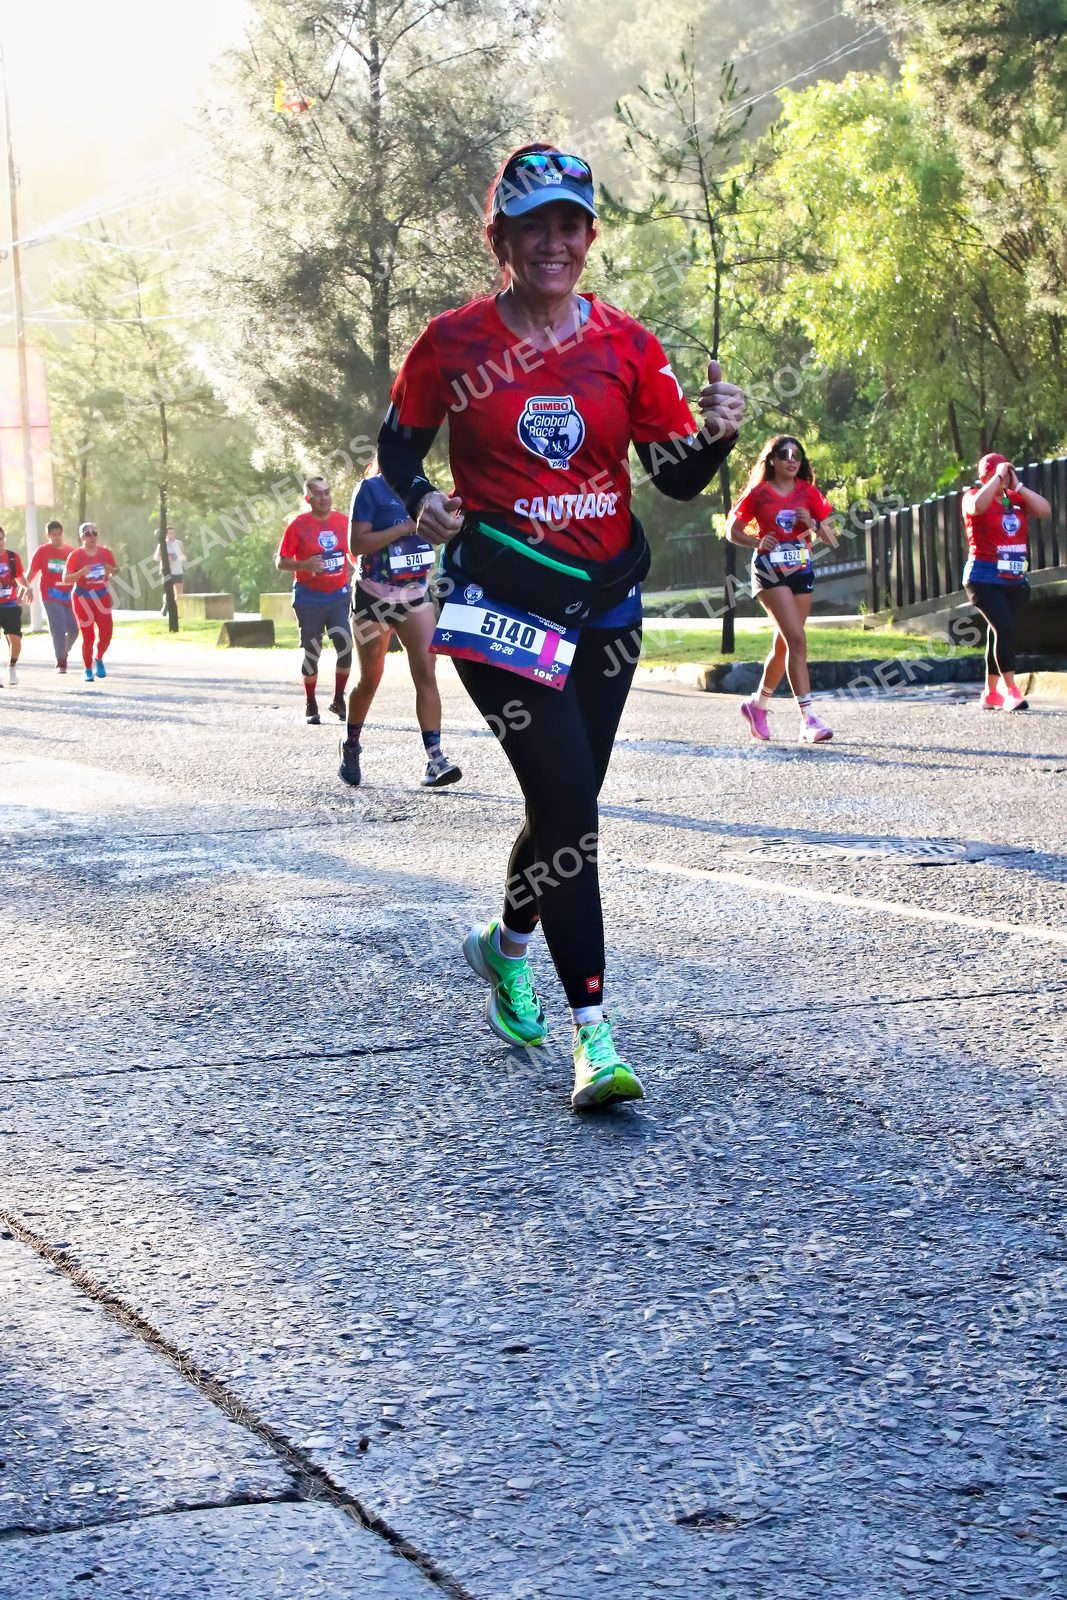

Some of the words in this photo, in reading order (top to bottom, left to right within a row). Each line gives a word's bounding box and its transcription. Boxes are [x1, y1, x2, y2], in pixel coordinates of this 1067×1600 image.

[532, 402, 569, 411] BIMBO
[534, 415, 568, 427] Global
[529, 425, 555, 437] Race
[514, 492, 618, 522] SANTIAGO
[406, 554, 423, 566] 5741
[480, 612, 537, 649] 5140
[533, 668, 554, 681] 10K
